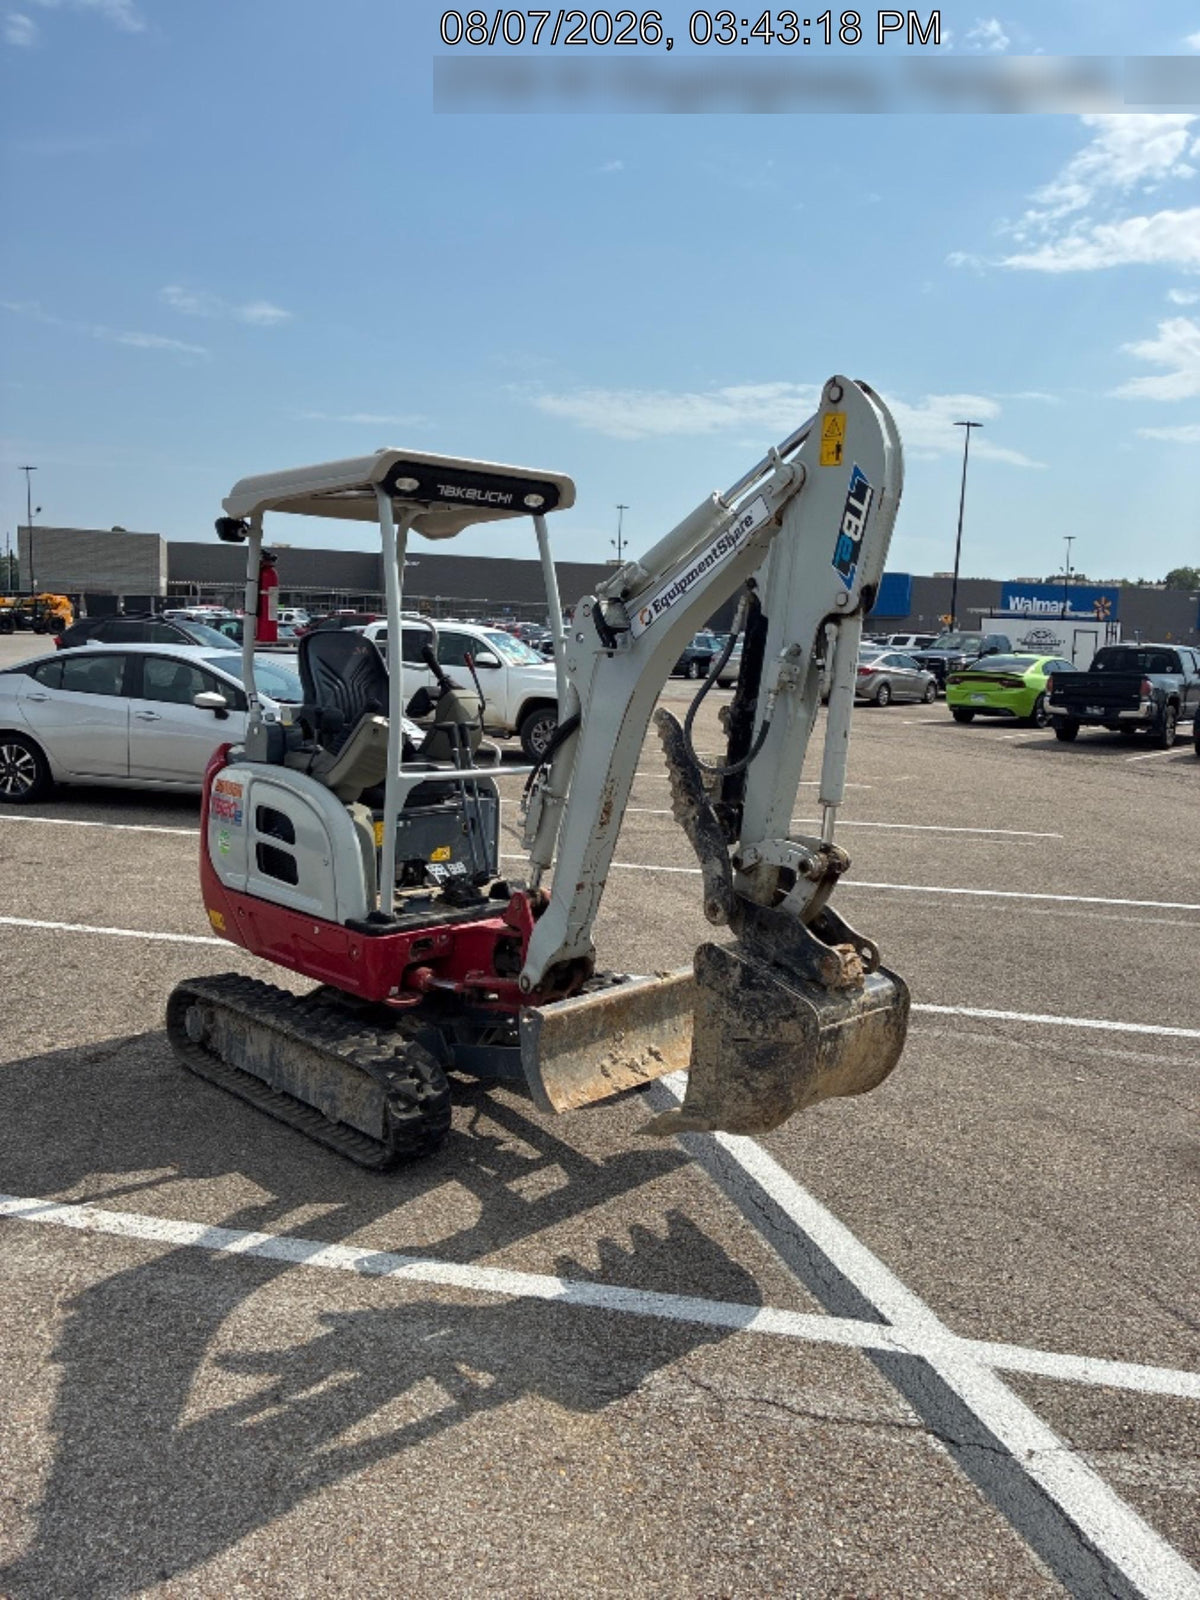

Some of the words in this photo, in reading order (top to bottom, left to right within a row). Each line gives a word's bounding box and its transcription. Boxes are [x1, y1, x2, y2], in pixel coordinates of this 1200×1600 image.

[437, 484, 513, 504] TAKEUCHI
[651, 514, 754, 614] EquipmentShare
[1008, 595, 1073, 612] Walmart
